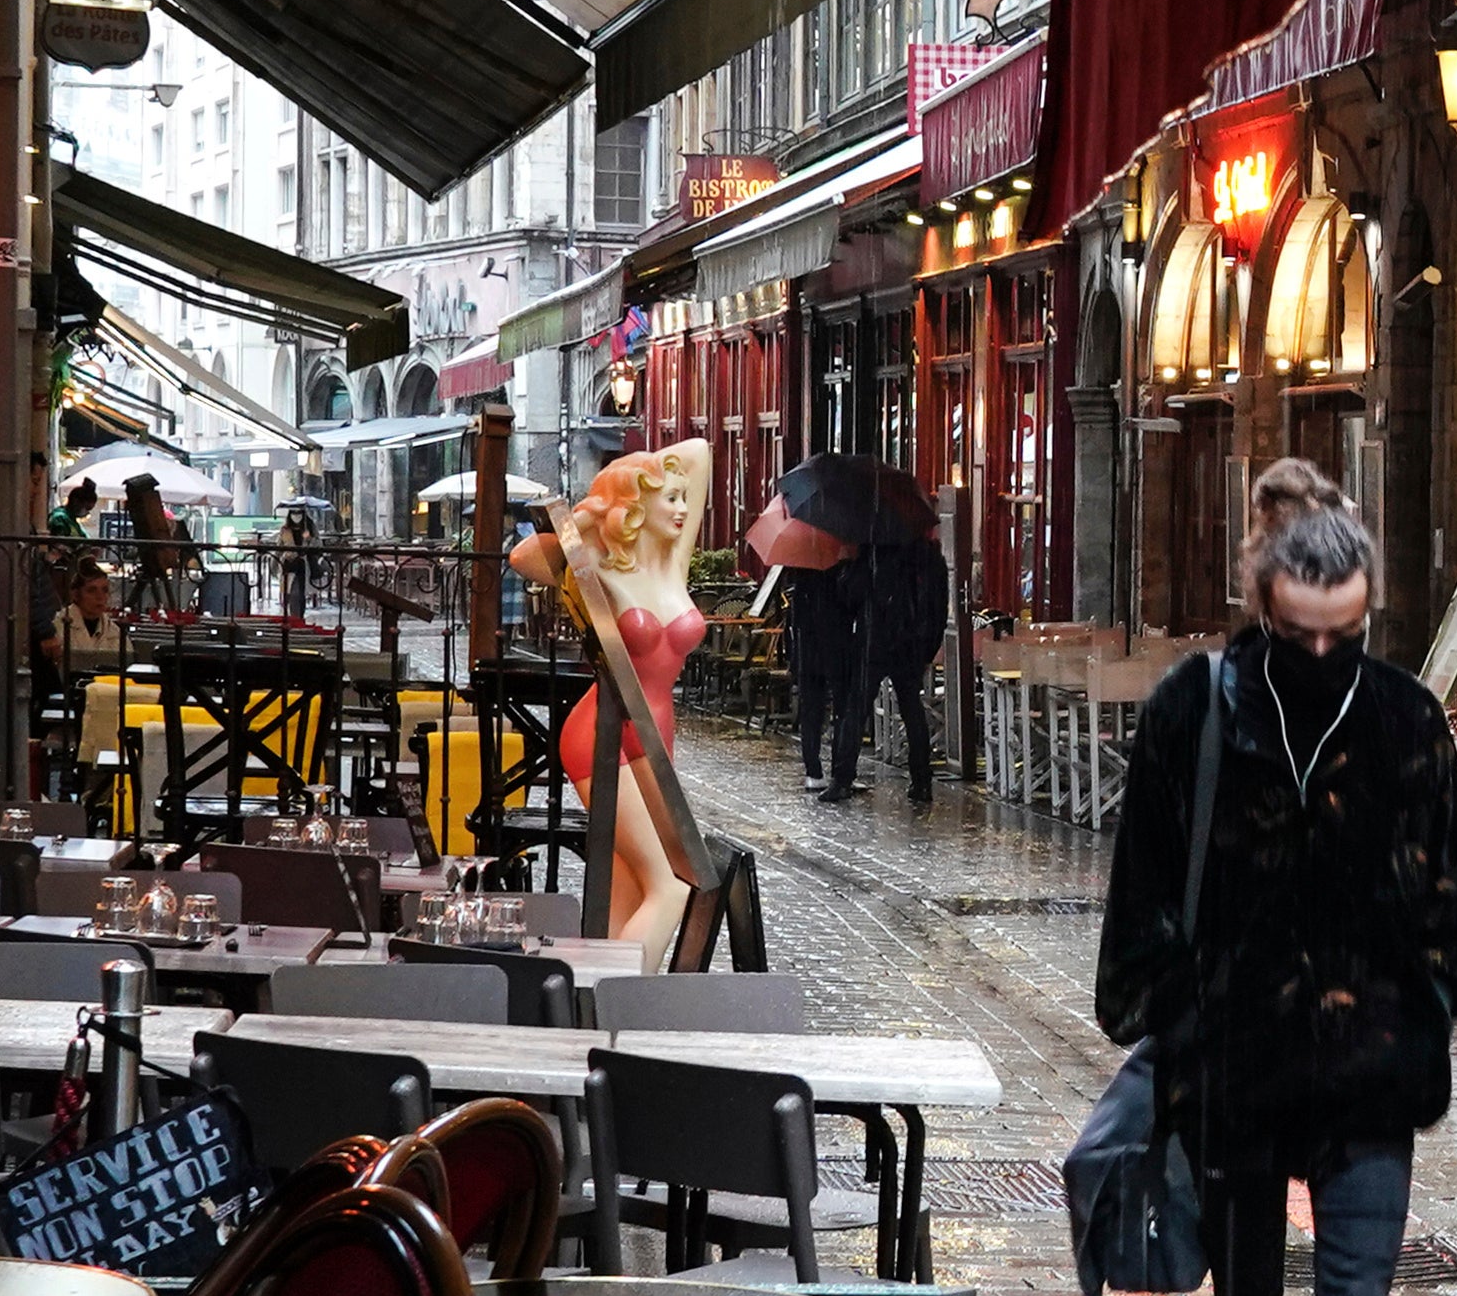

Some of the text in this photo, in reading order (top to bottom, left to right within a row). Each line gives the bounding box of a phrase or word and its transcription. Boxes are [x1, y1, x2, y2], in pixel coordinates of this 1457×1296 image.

[51, 20, 140, 45] des Pâtes
[721, 158, 744, 178] LE
[693, 199, 716, 218] DE
[15, 1143, 232, 1262] NON STOP
[112, 1204, 197, 1263] DAY
